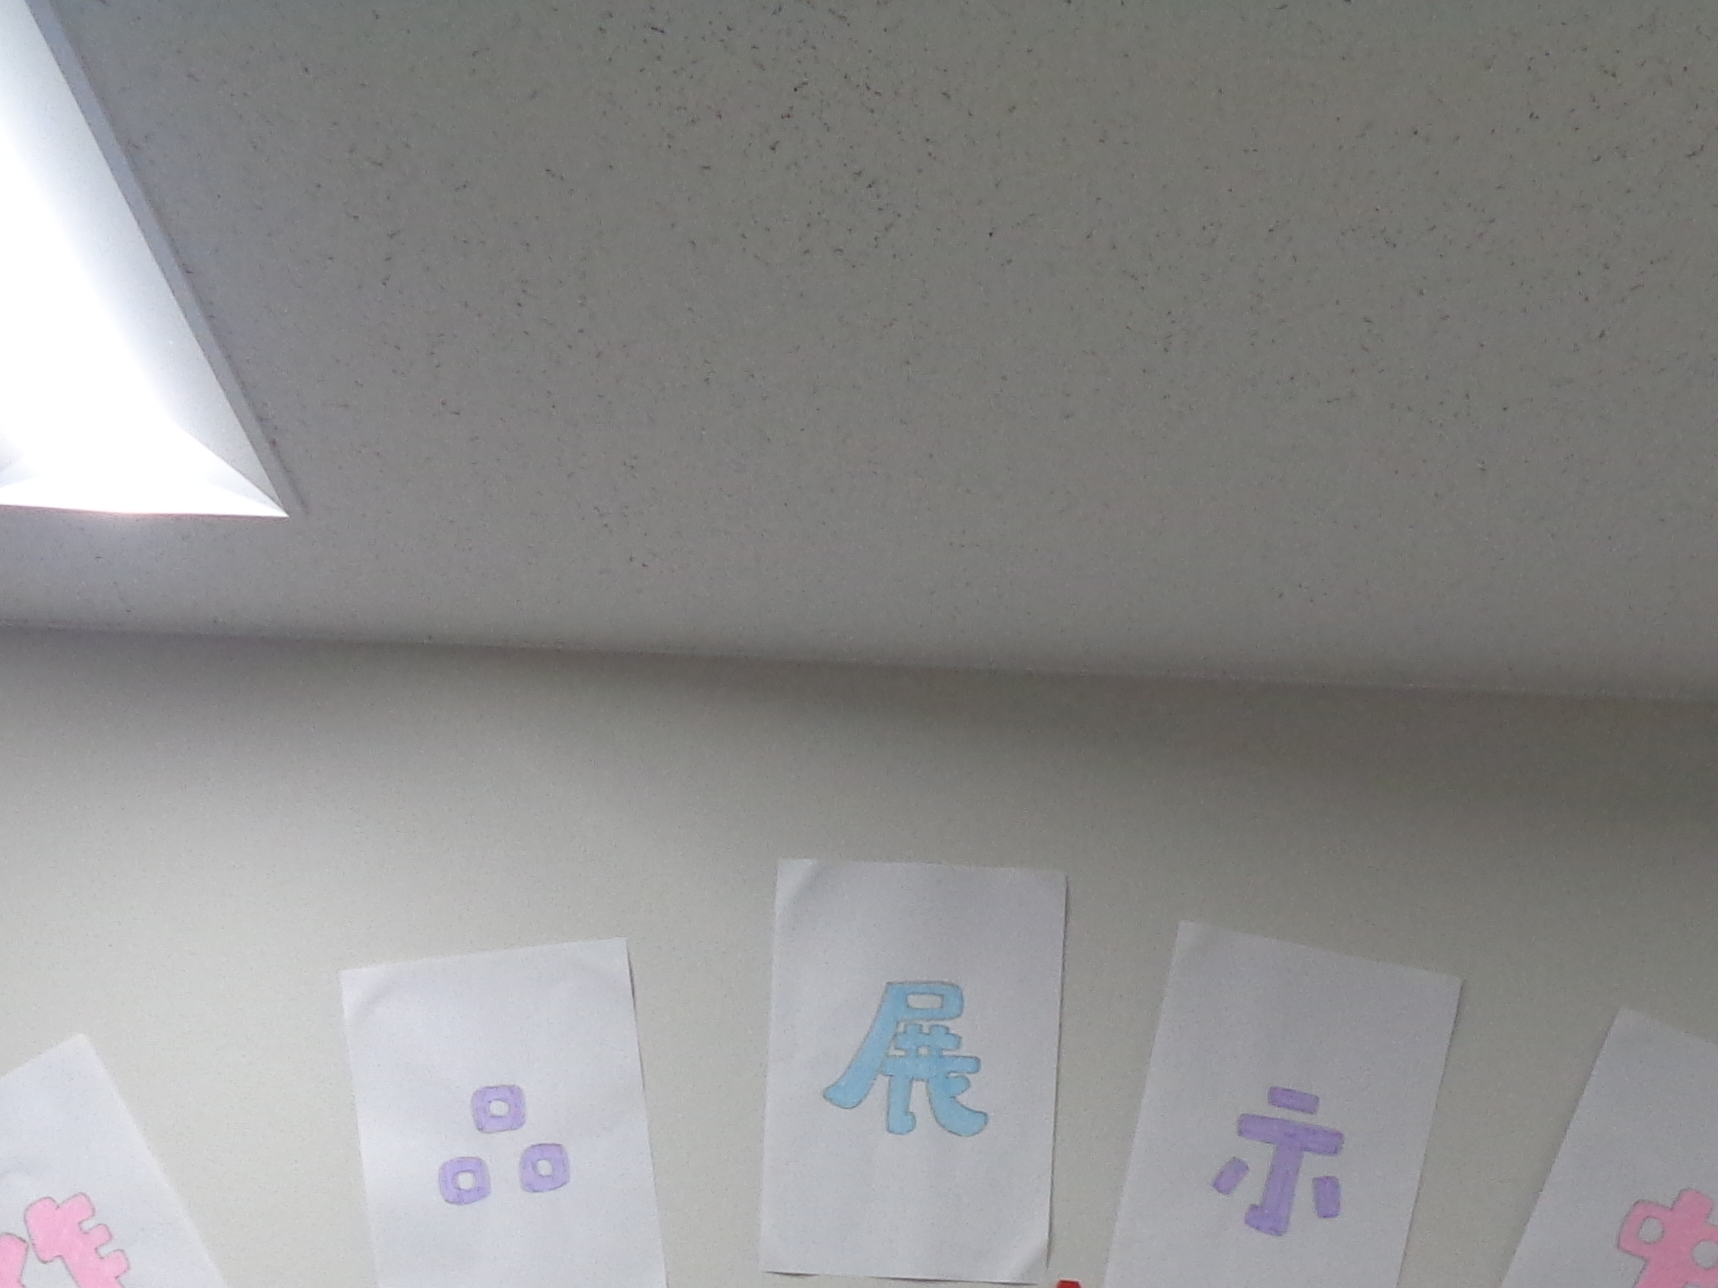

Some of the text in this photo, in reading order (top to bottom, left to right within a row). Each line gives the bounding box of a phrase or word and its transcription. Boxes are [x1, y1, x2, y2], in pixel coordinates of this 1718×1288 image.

[439, 1084, 571, 1206] 品
[823, 980, 990, 1138] 展
[1212, 1086, 1345, 1238] 示
